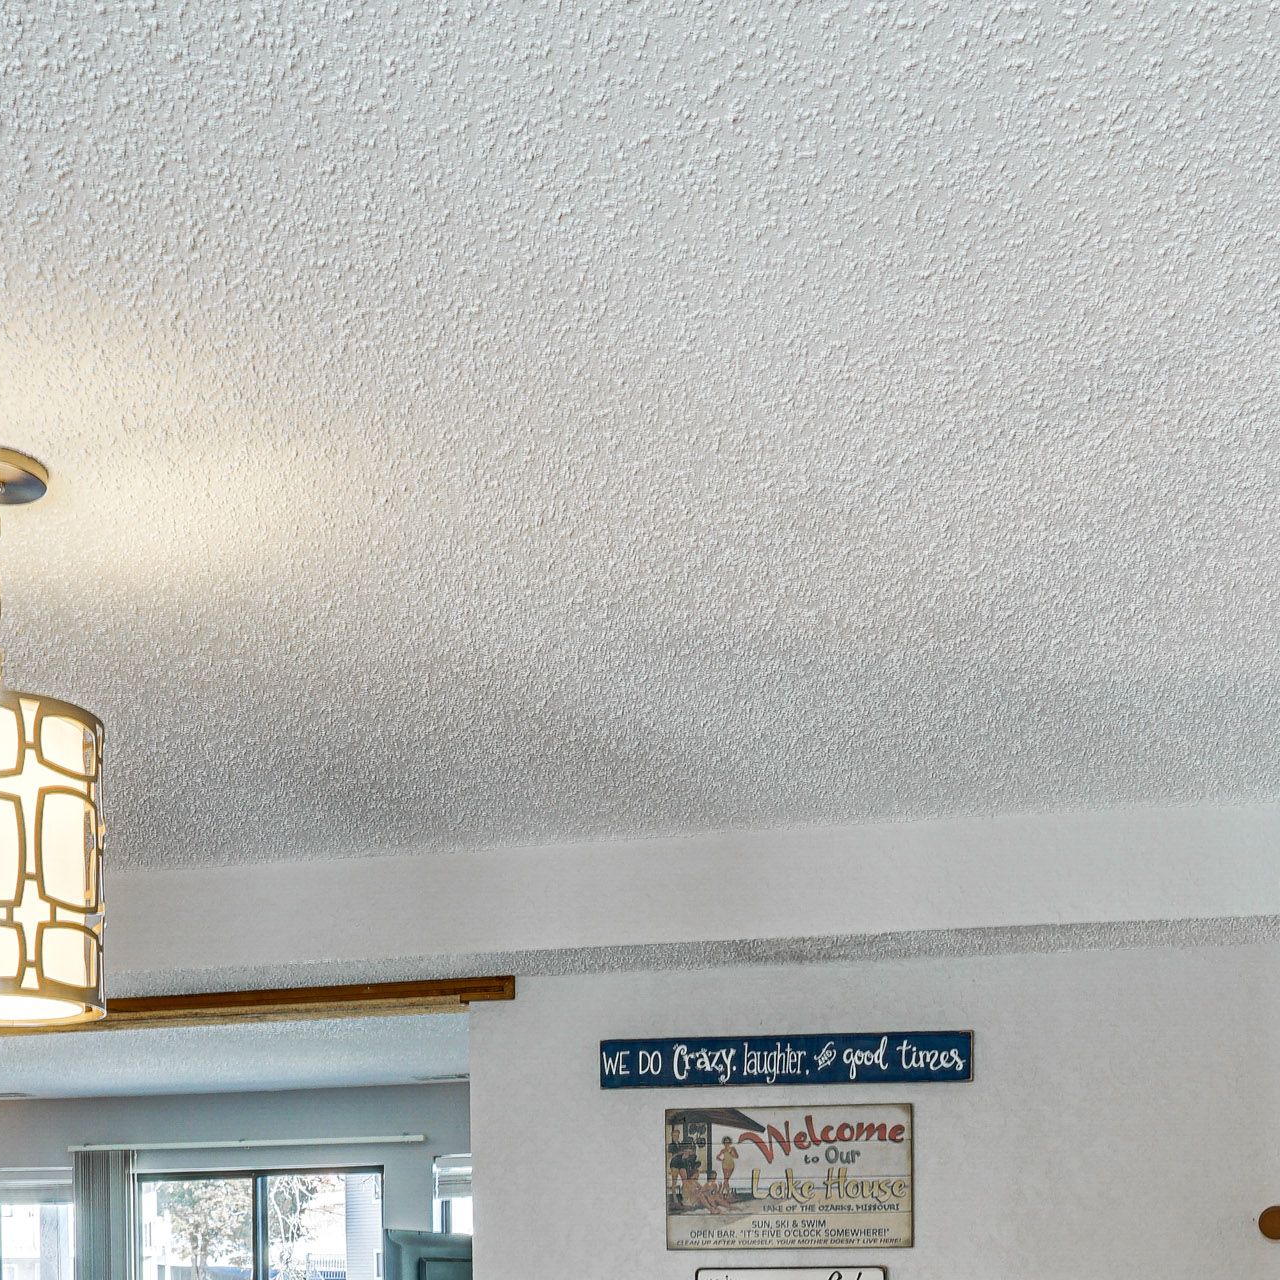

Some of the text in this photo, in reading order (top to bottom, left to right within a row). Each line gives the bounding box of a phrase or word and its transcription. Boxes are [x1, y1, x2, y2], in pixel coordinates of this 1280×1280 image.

[602, 1050, 630, 1075] WE
[638, 1050, 662, 1075] DO
[742, 1041, 810, 1085] laughter,
[842, 1035, 889, 1080] good
[896, 1039, 967, 1072] times
[737, 1114, 906, 1164] Welcome
[803, 1145, 861, 1165] to Our
[751, 1166, 907, 1204] Lake House
[762, 1205, 784, 1213] LAKE
[785, 1204, 797, 1212] OF
[799, 1204, 817, 1212] THE
[855, 1202, 900, 1212] MISSOURI
[751, 1218, 827, 1230] SUN, SKI & SWIM
[689, 1229, 717, 1238] OPEN
[761, 1229, 782, 1238] FIVE
[783, 1228, 821, 1238] O'CLOCK
[796, 1237, 829, 1245] MOTHER
[862, 1237, 878, 1245] LIVE
